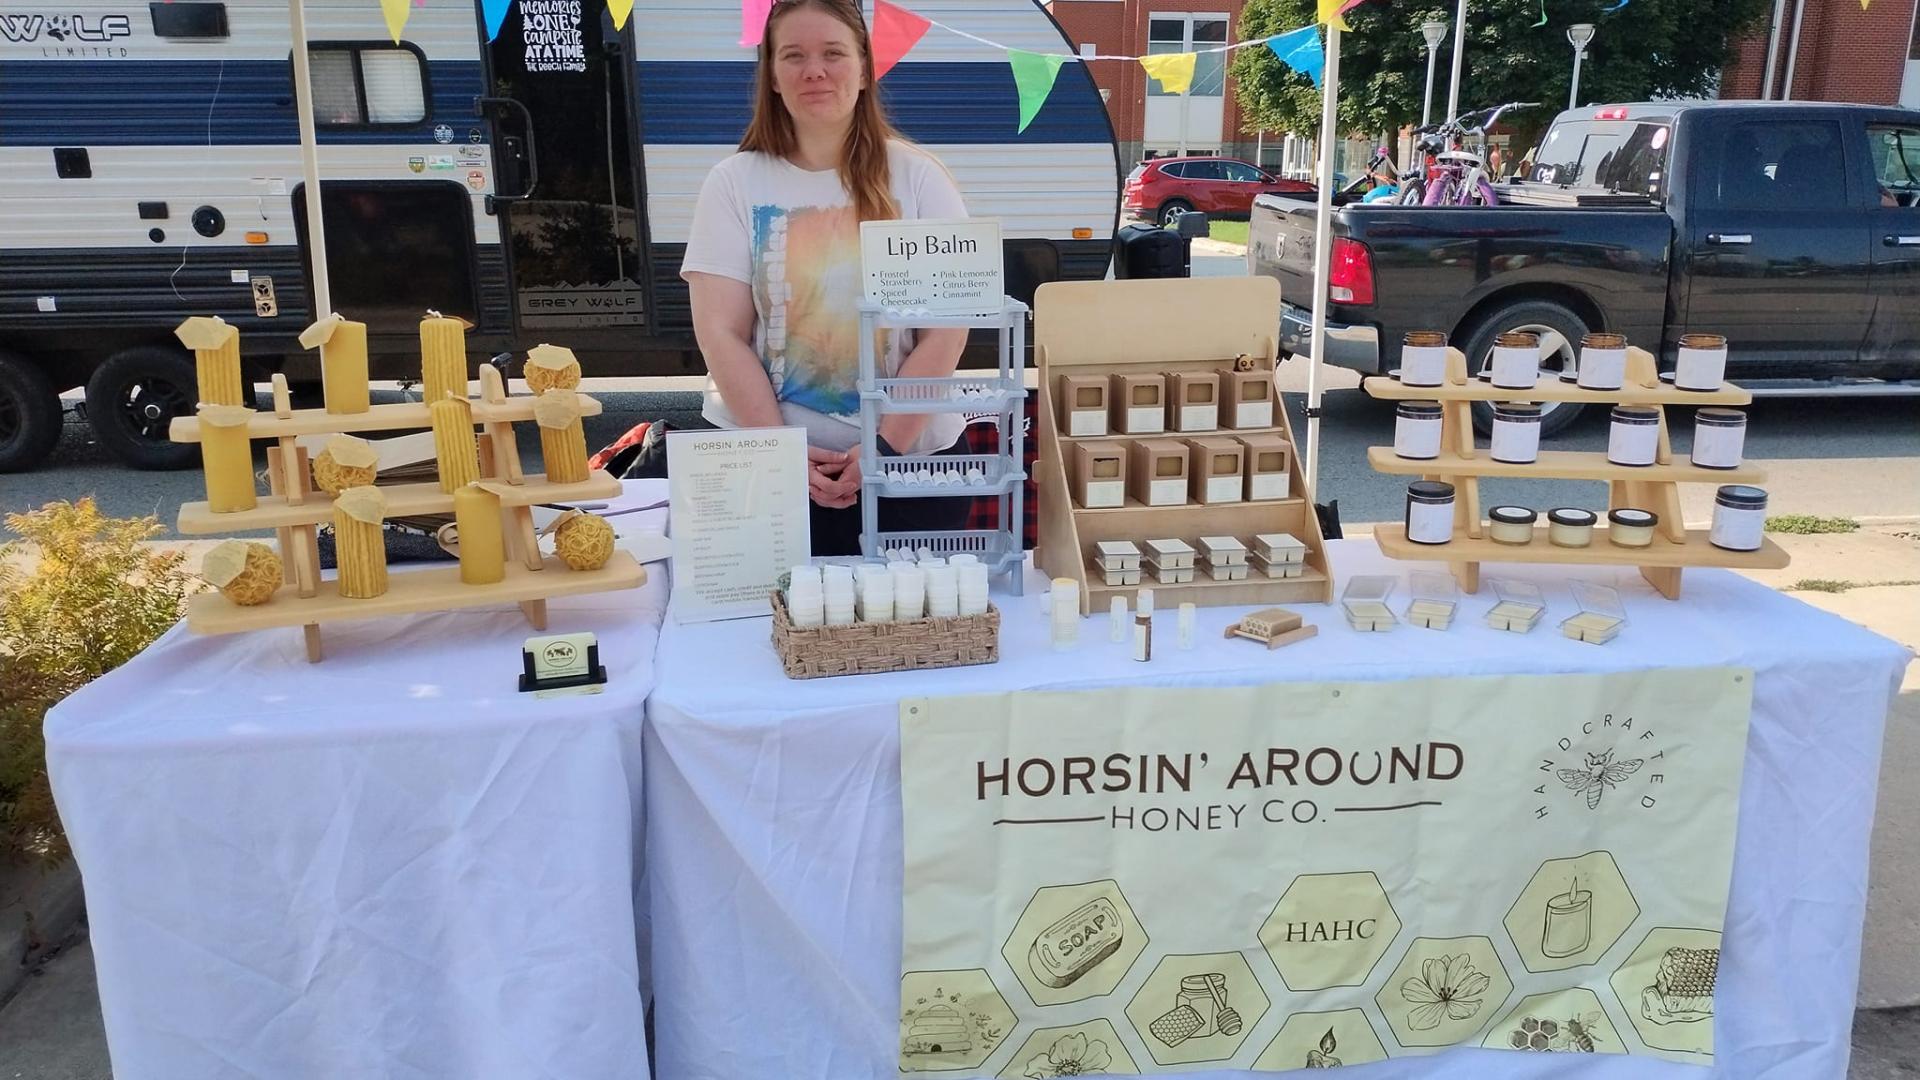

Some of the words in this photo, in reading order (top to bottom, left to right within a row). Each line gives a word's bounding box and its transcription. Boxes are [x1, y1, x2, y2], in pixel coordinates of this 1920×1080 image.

[533, 14, 571, 30] ONE
[42, 47, 128, 58] LIMITED
[525, 45, 543, 58] AT
[543, 45, 554, 58] A
[552, 45, 585, 58] TIME
[887, 236, 918, 260] Lip
[925, 234, 977, 255] Balm
[879, 269, 909, 279] Frosted
[940, 270, 957, 279] Pink
[959, 269, 999, 279] Lemonade
[880, 278, 923, 288] Strawberry
[942, 279, 966, 289] Citrus
[967, 278, 990, 289] Berry
[880, 288, 907, 299] Spiced
[942, 290, 981, 299] Cinnamint
[528, 298, 578, 308] GREY
[880, 297, 927, 306] Cheesecake
[976, 751, 1209, 800] HORSIN'
[1226, 741, 1464, 790] AROUND
[1533, 713, 1664, 820] HANDCRAFTED
[1111, 803, 1247, 832] HONEY
[1262, 799, 1327, 824] CO.
[1058, 914, 1106, 957] SOAP
[1284, 918, 1377, 943] HAHC
